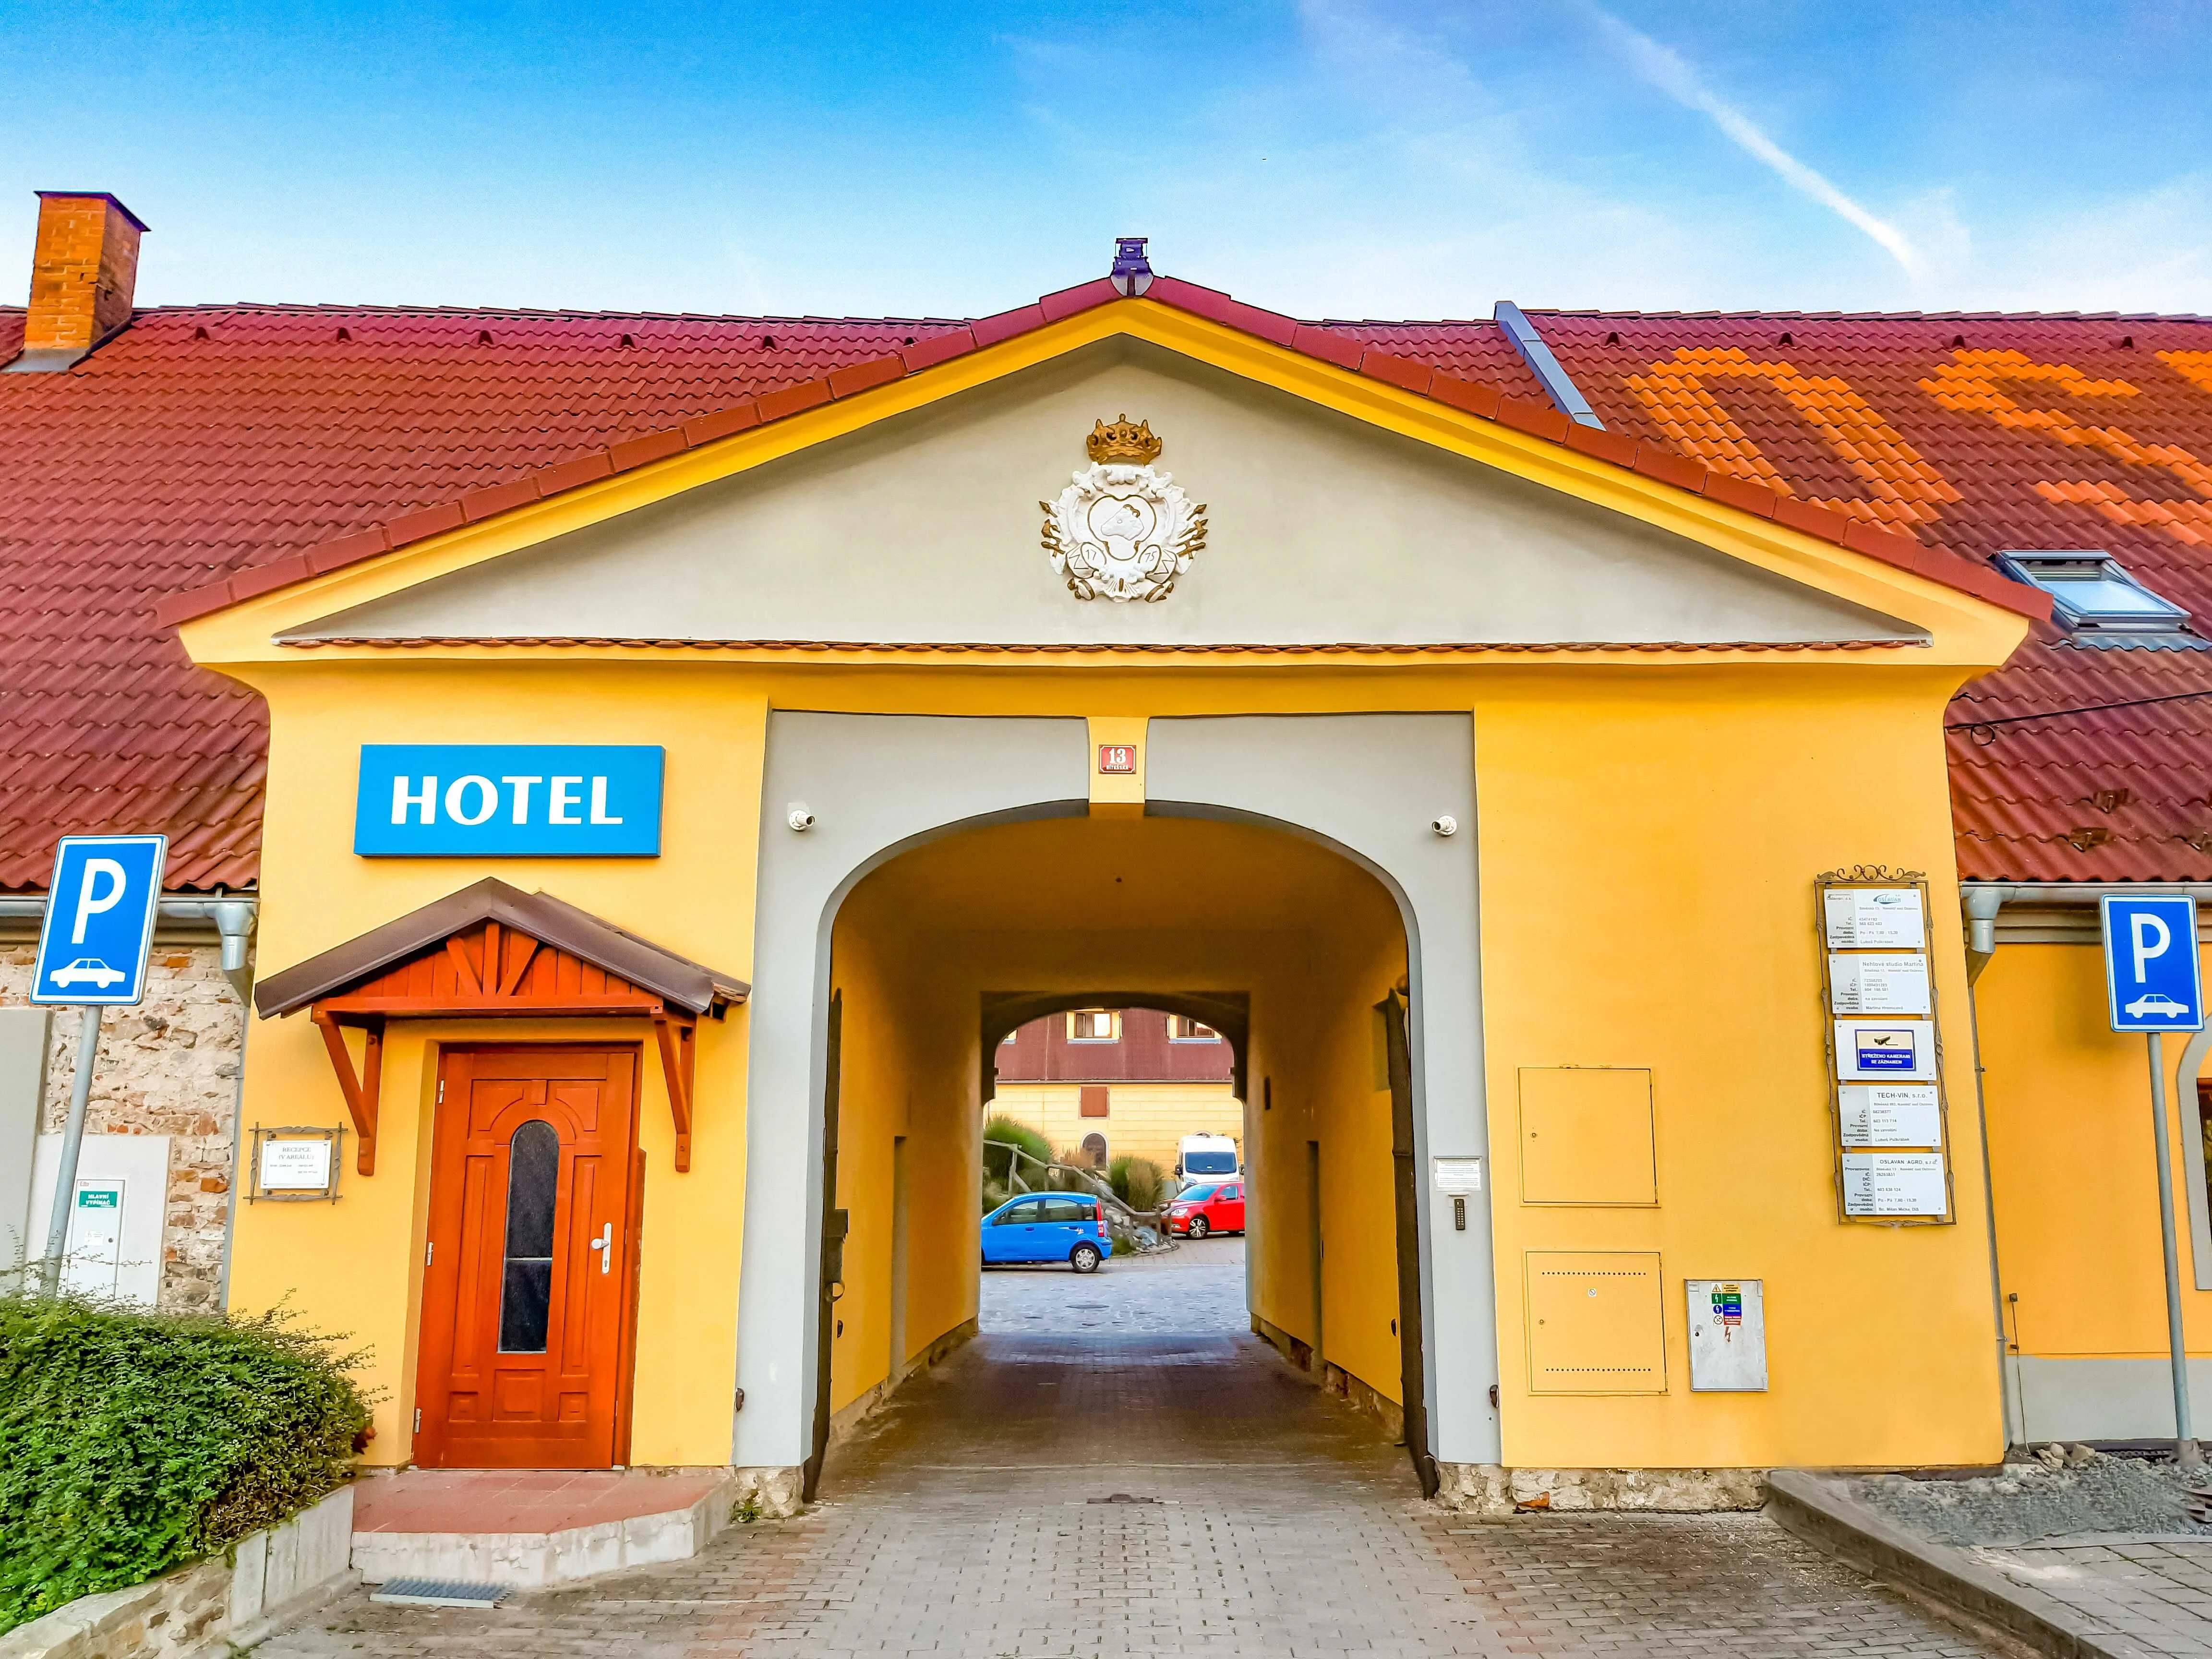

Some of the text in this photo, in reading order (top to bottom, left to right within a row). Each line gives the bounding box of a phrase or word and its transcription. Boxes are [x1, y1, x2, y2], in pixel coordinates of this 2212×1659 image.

[1085, 549, 1157, 562] 17 75
[1109, 748, 1126, 764] 13
[391, 775, 623, 825] HOTEL
[72, 858, 126, 944] P
[2130, 913, 2171, 983] P
